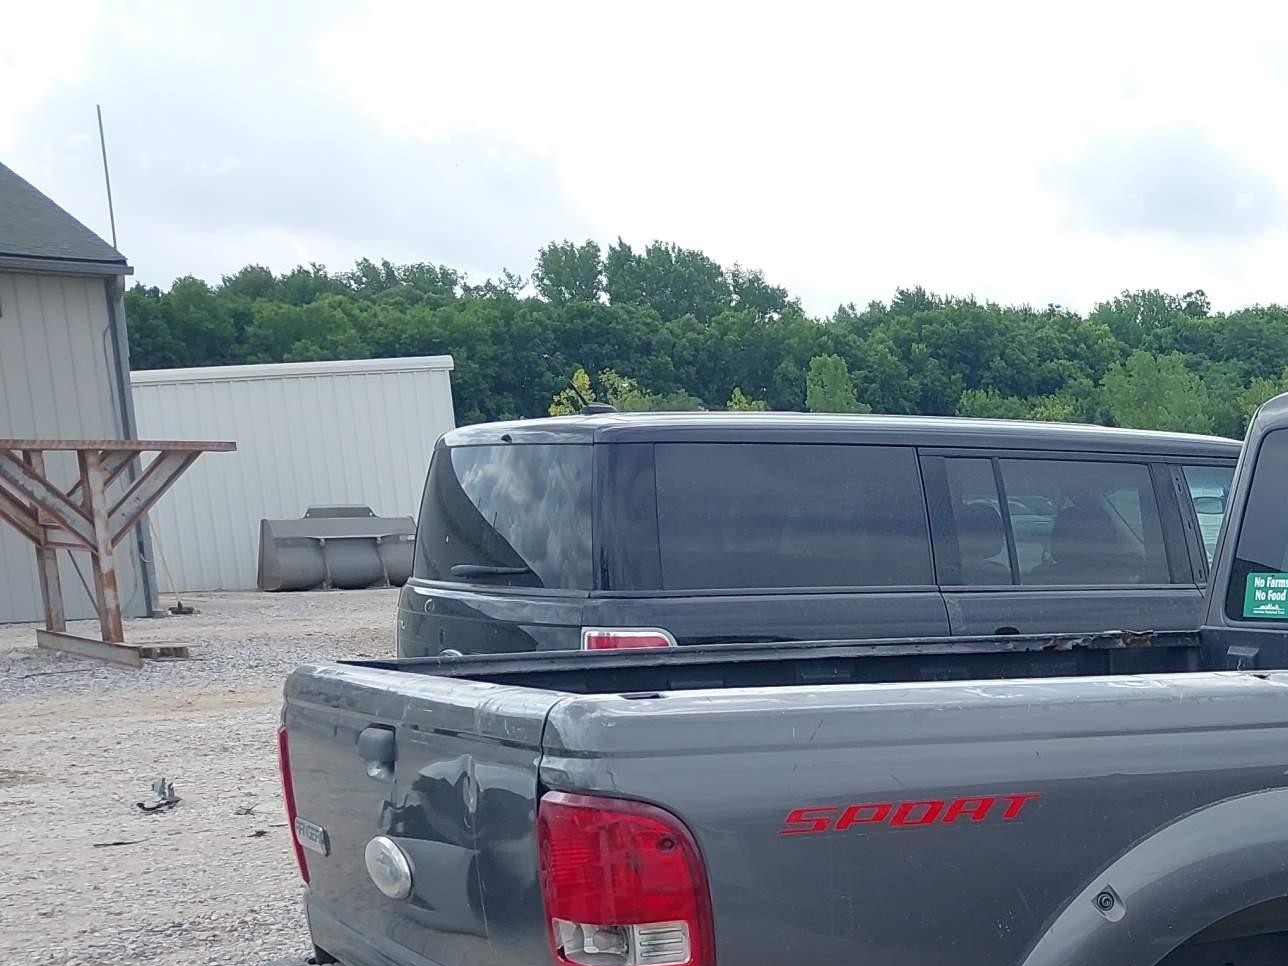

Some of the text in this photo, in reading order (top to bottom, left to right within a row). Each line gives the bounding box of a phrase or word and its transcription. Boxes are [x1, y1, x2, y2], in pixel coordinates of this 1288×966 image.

[1254, 576, 1265, 588] No
[1255, 589, 1287, 601] No Food
[778, 792, 1041, 838] SPORT
